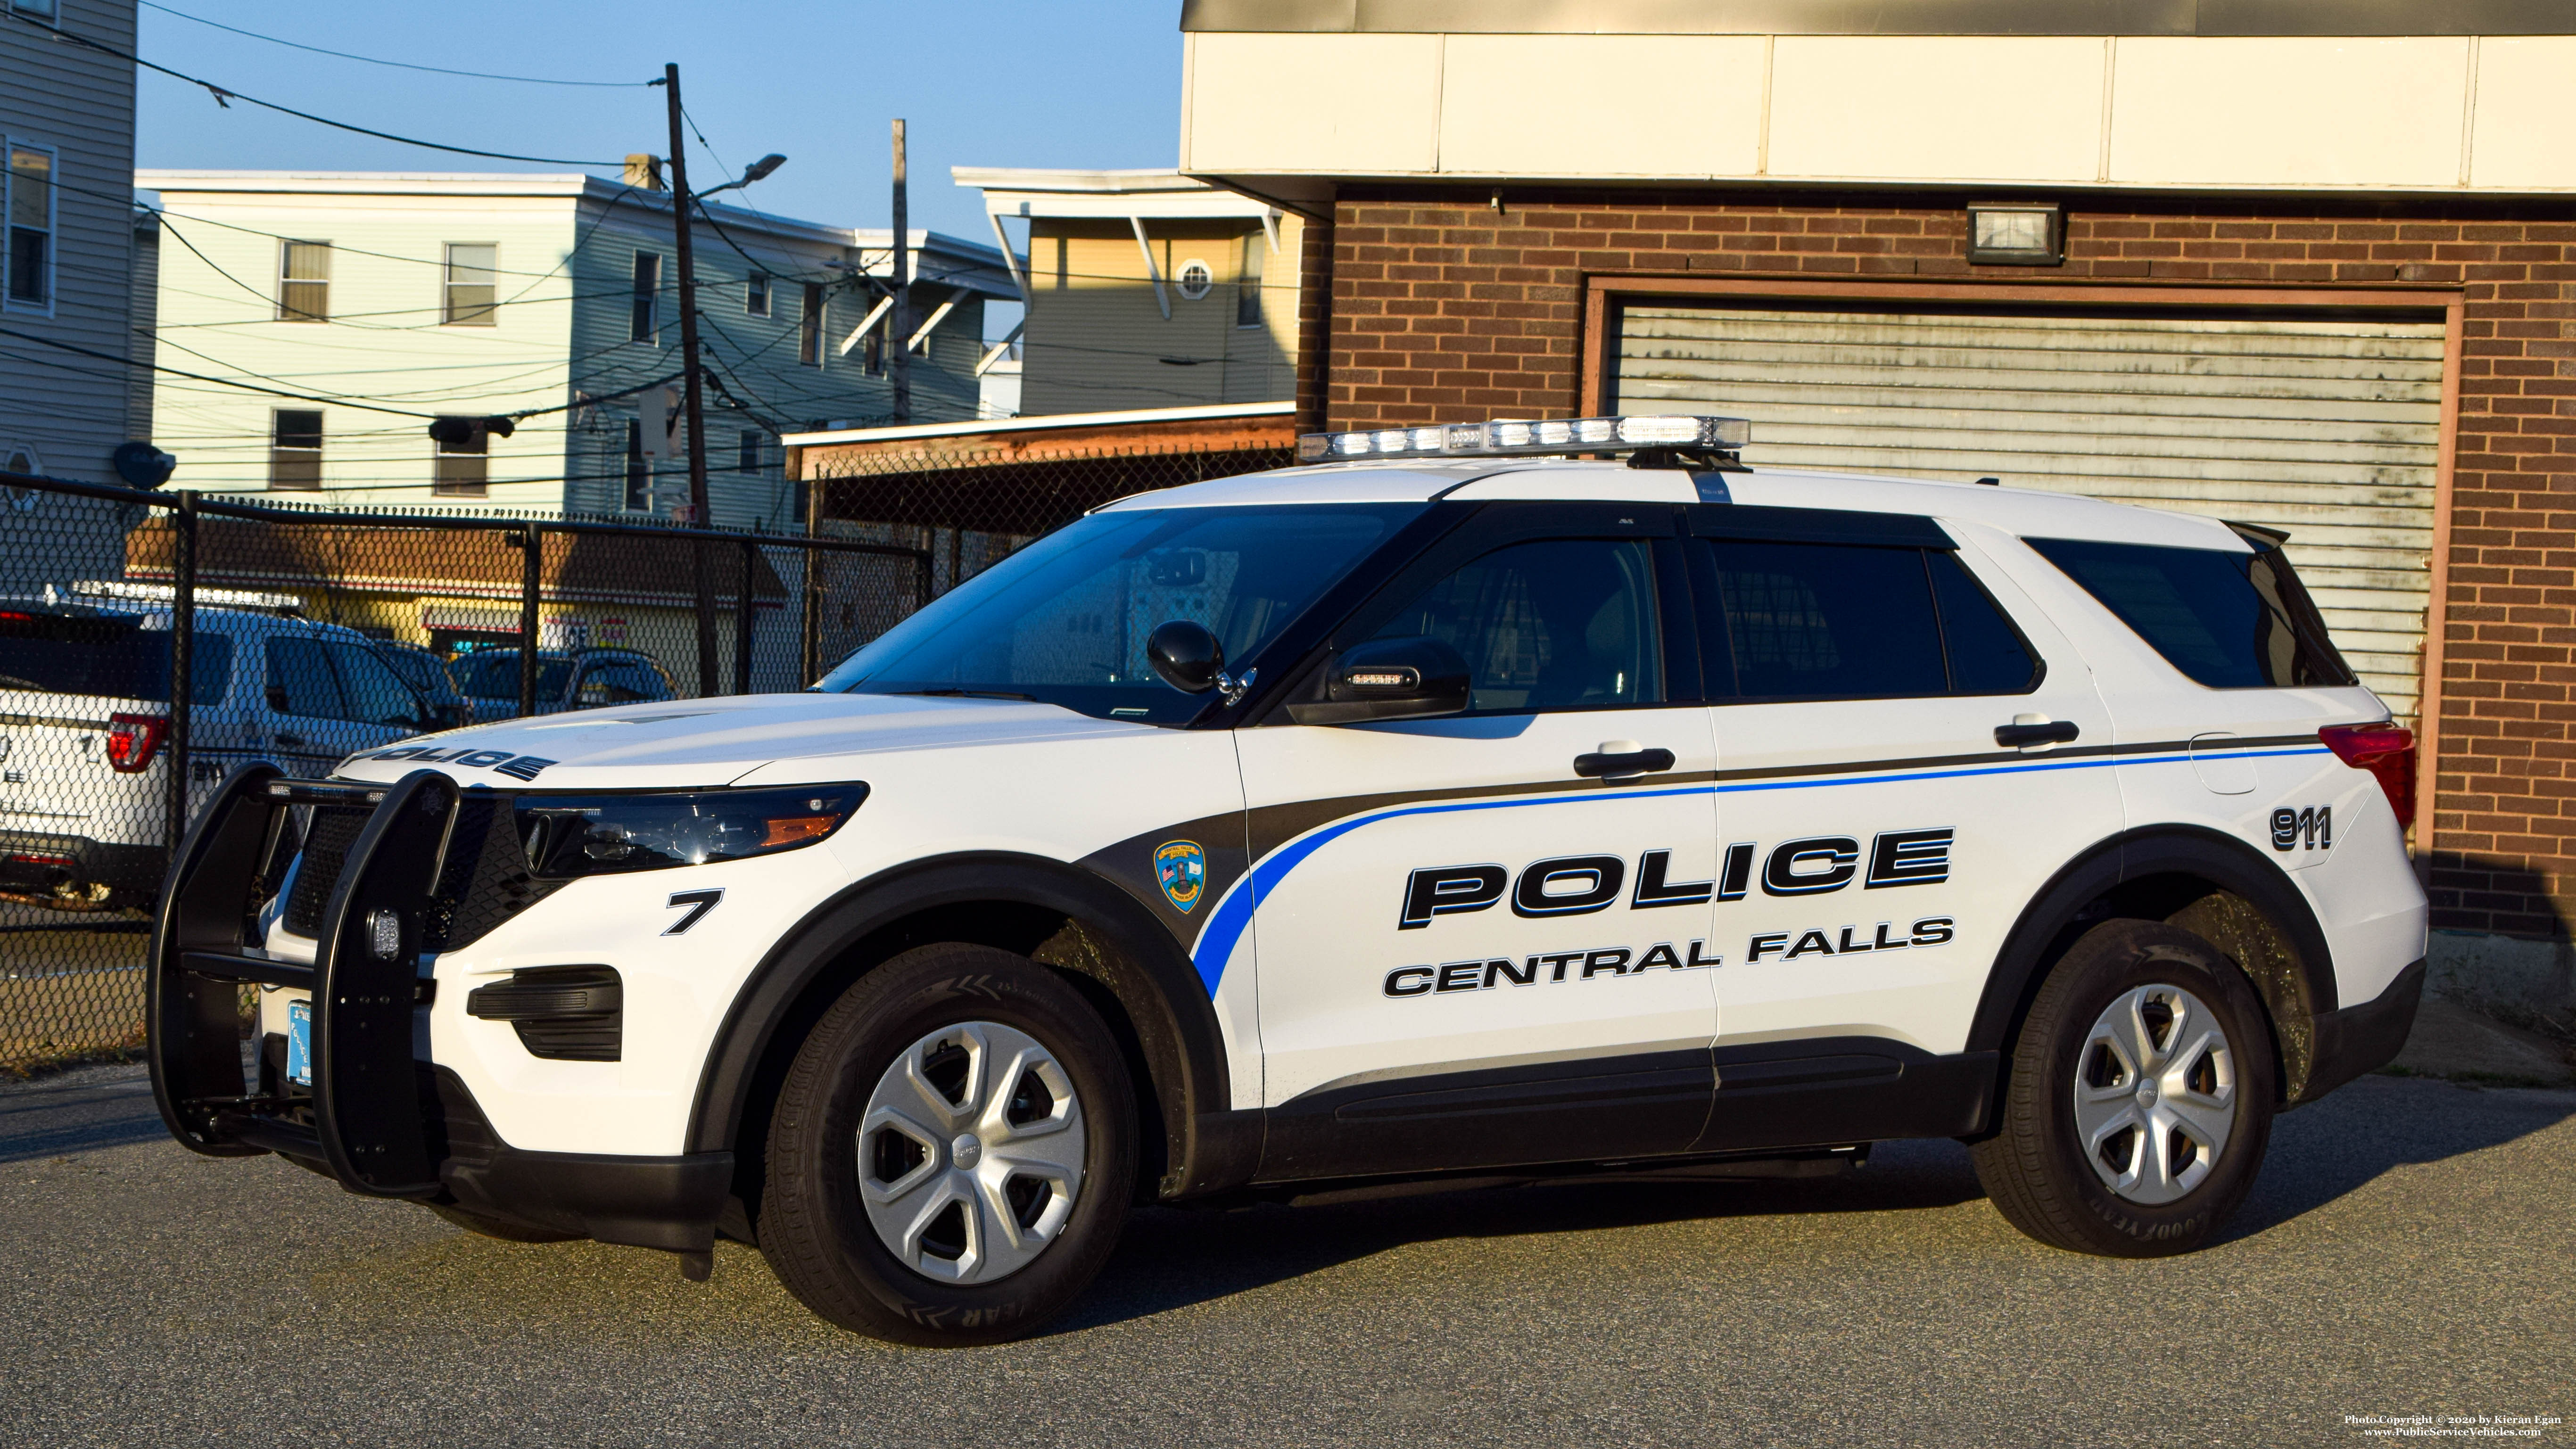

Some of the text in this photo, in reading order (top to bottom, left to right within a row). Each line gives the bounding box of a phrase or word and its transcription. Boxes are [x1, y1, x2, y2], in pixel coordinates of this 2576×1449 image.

[2270, 804, 2332, 851] 911
[1398, 826, 1956, 930] POLICE
[659, 887, 726, 937] 7
[1382, 915, 1956, 999] CENTRAL FALLS
[291, 1022, 307, 1063] POLICE
